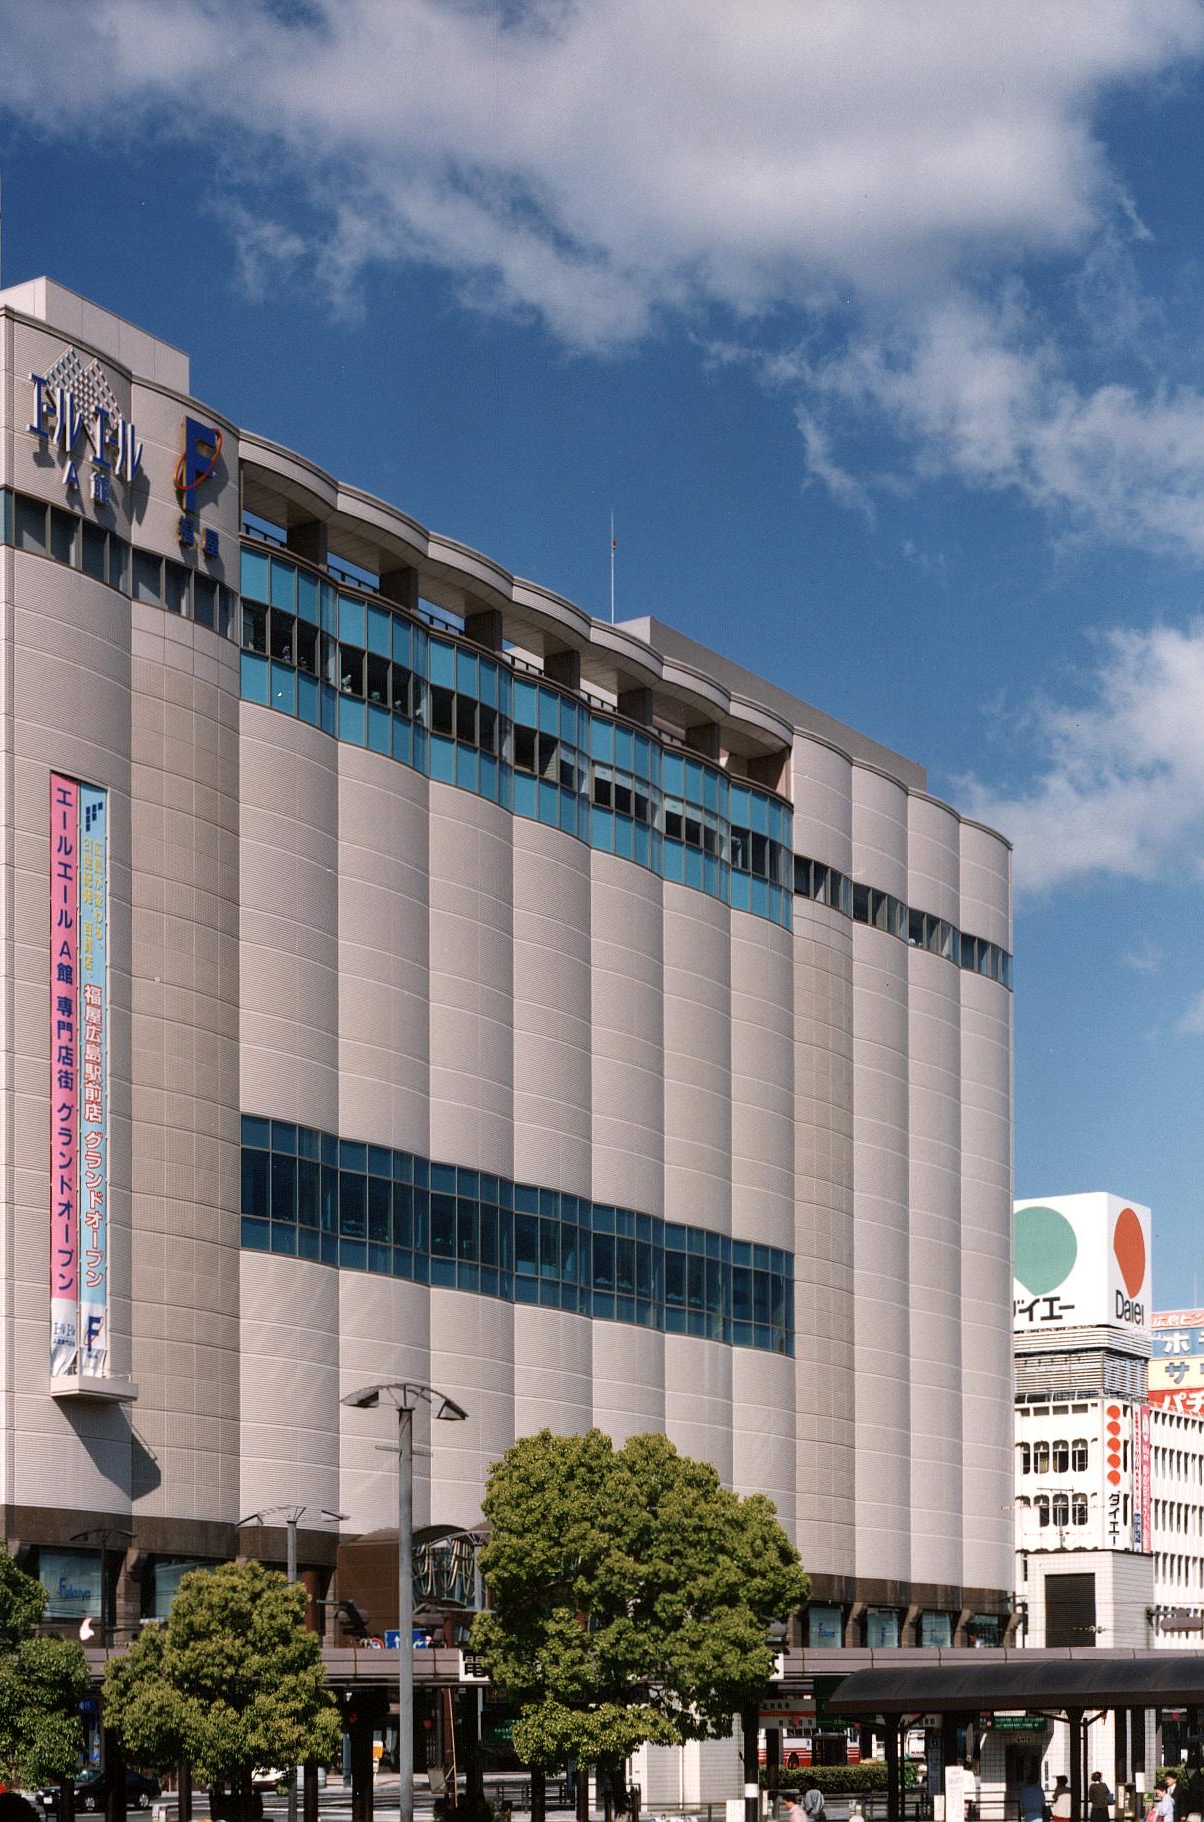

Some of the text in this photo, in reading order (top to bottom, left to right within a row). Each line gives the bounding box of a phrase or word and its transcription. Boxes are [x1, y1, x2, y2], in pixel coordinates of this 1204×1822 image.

[26, 372, 144, 483] エールエール
[84, 1130, 104, 1289] グランドオープン
[1115, 1288, 1145, 1327] Daiei
[1164, 1361, 1204, 1384] サ
[1108, 1490, 1121, 1545] ダイエー
